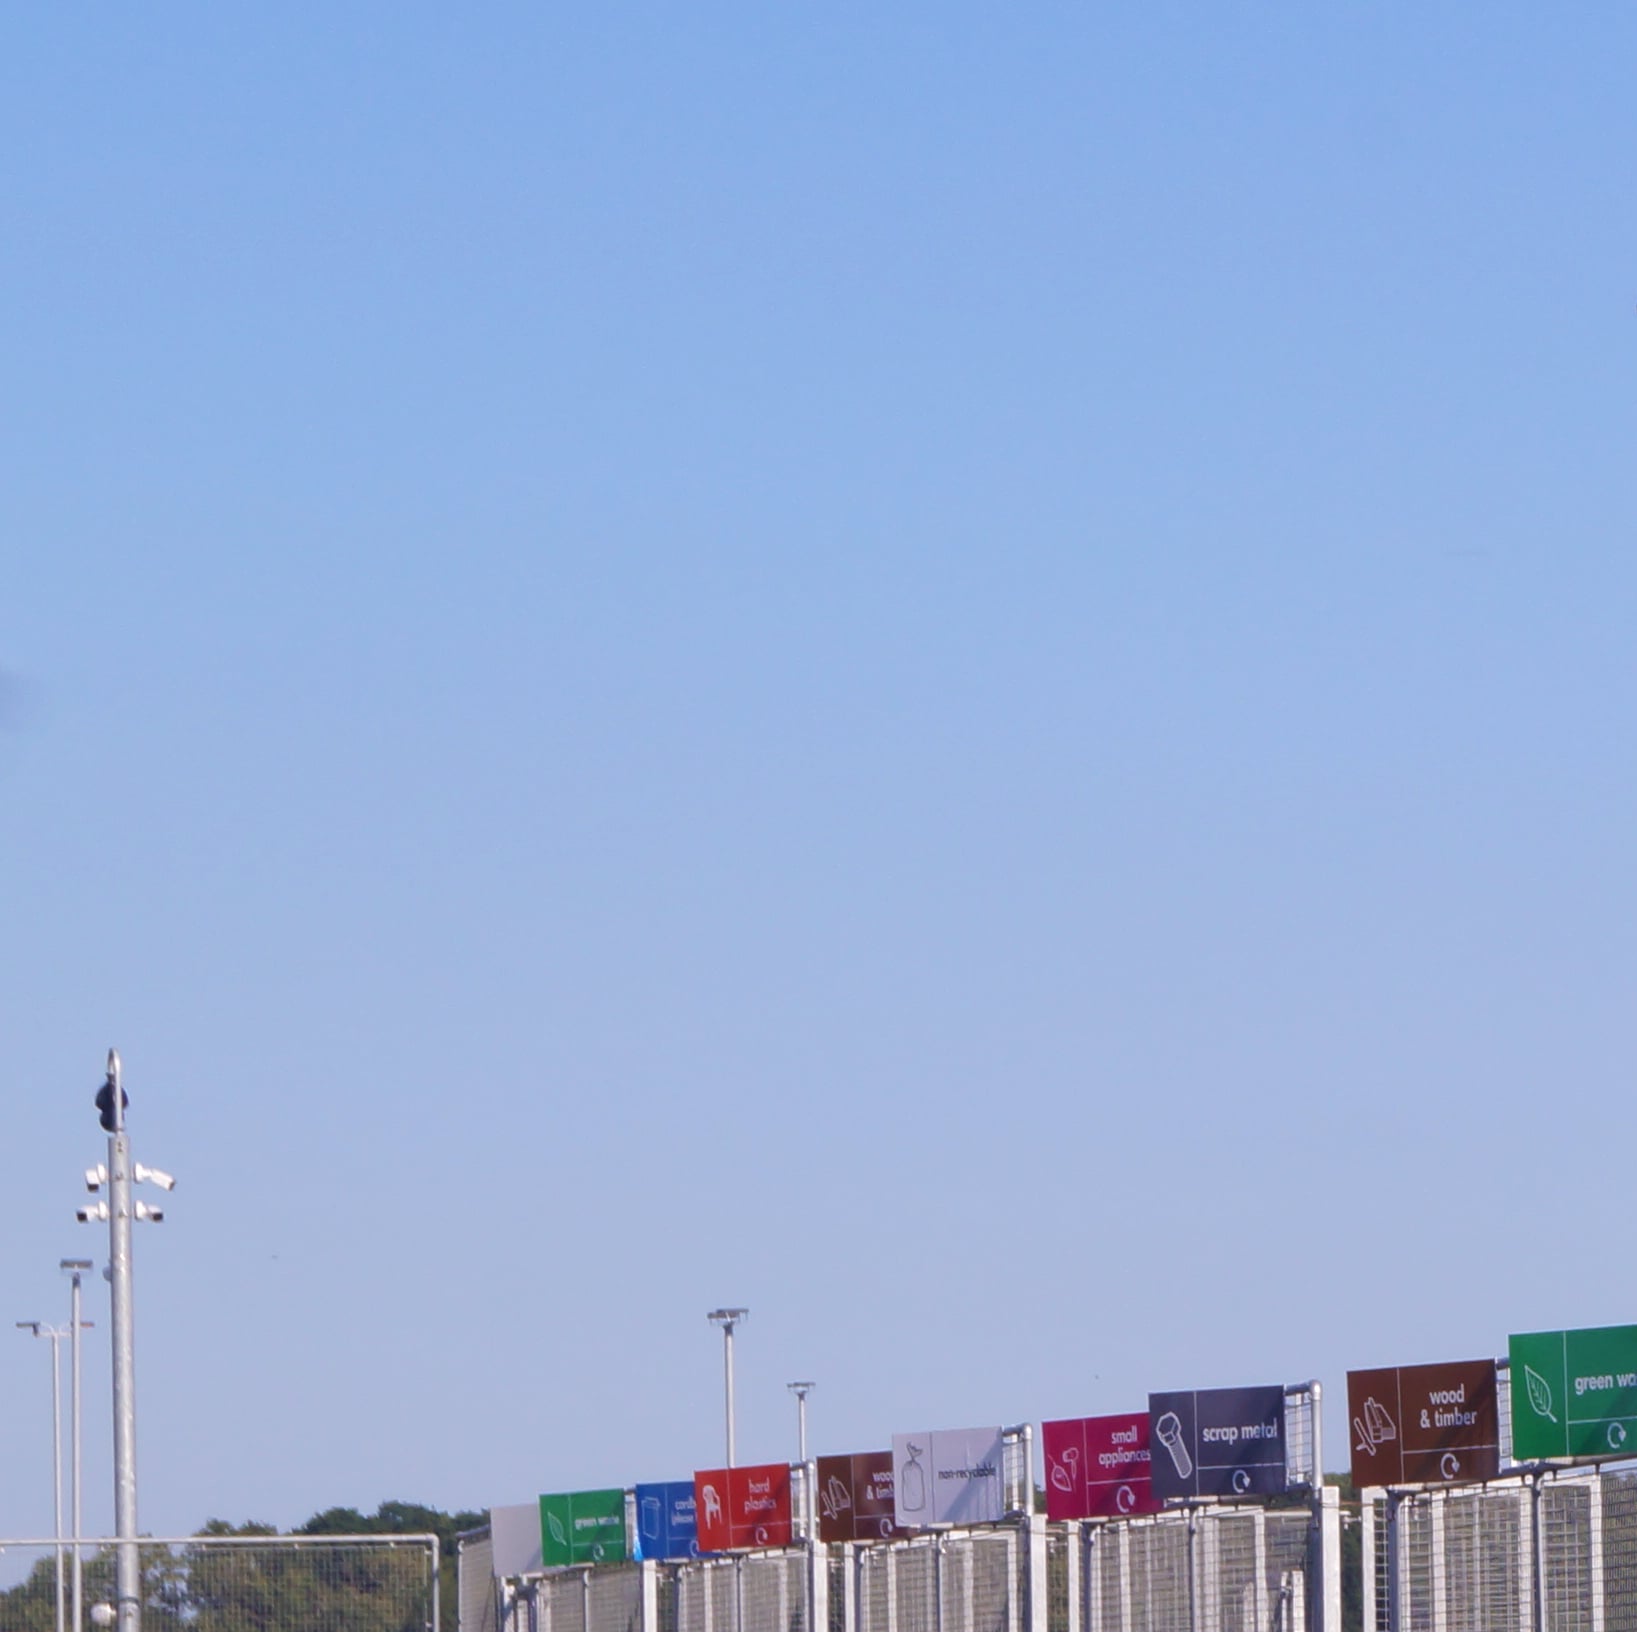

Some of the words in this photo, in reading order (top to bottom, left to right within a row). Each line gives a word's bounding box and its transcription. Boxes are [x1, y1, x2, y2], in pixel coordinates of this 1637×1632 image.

[1429, 1384, 1465, 1405] wood
[1575, 1374, 1614, 1395] green
[1420, 1410, 1431, 1428] &
[1434, 1408, 1477, 1427] timber
[1111, 1425, 1138, 1445] small
[1202, 1425, 1238, 1445] scrap
[1241, 1417, 1278, 1440] metal
[1098, 1447, 1151, 1469] appliances
[748, 1477, 770, 1493] hard
